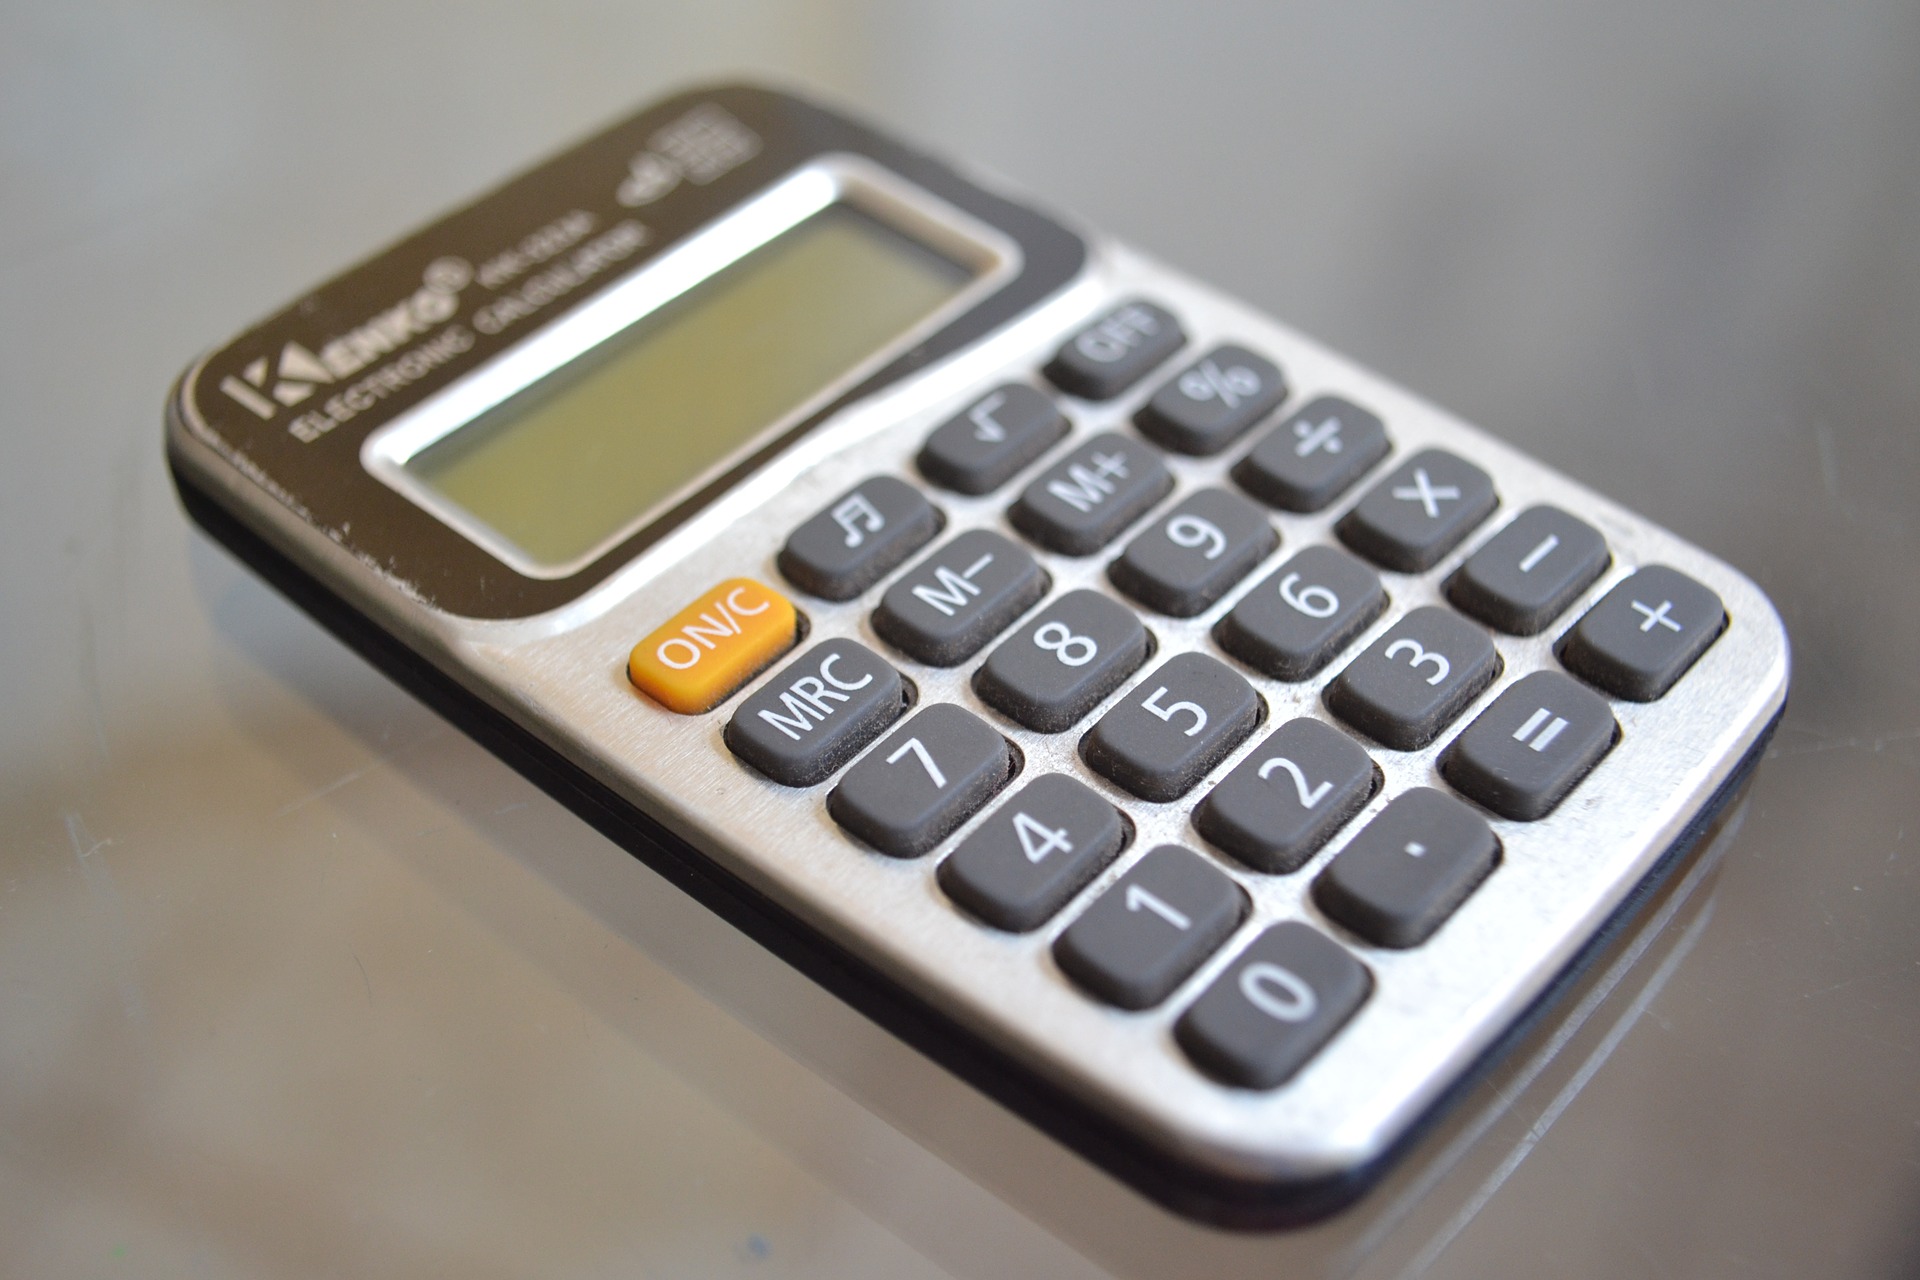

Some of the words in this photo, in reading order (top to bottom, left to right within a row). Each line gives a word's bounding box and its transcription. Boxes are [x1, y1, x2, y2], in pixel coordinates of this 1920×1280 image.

[287, 324, 476, 443] ELECTRONIC
[472, 219, 651, 335] CALCULATOR
[1074, 307, 1160, 362] OFF
[1178, 360, 1261, 408] %
[1047, 451, 1129, 513] M+
[1166, 514, 1227, 559] 9
[1279, 572, 1339, 618] 6
[1631, 600, 1681, 632] +
[656, 586, 770, 670] ON/C
[1032, 621, 1098, 668] 8
[1384, 638, 1450, 686] 3
[757, 653, 873, 741] MRC
[1141, 686, 1208, 737] 5
[1512, 707, 1569, 752] =
[885, 737, 948, 790] 7
[1257, 757, 1334, 809] 2
[1011, 812, 1074, 864] 4
[1125, 884, 1190, 930] 1
[1239, 961, 1317, 1021] 0
